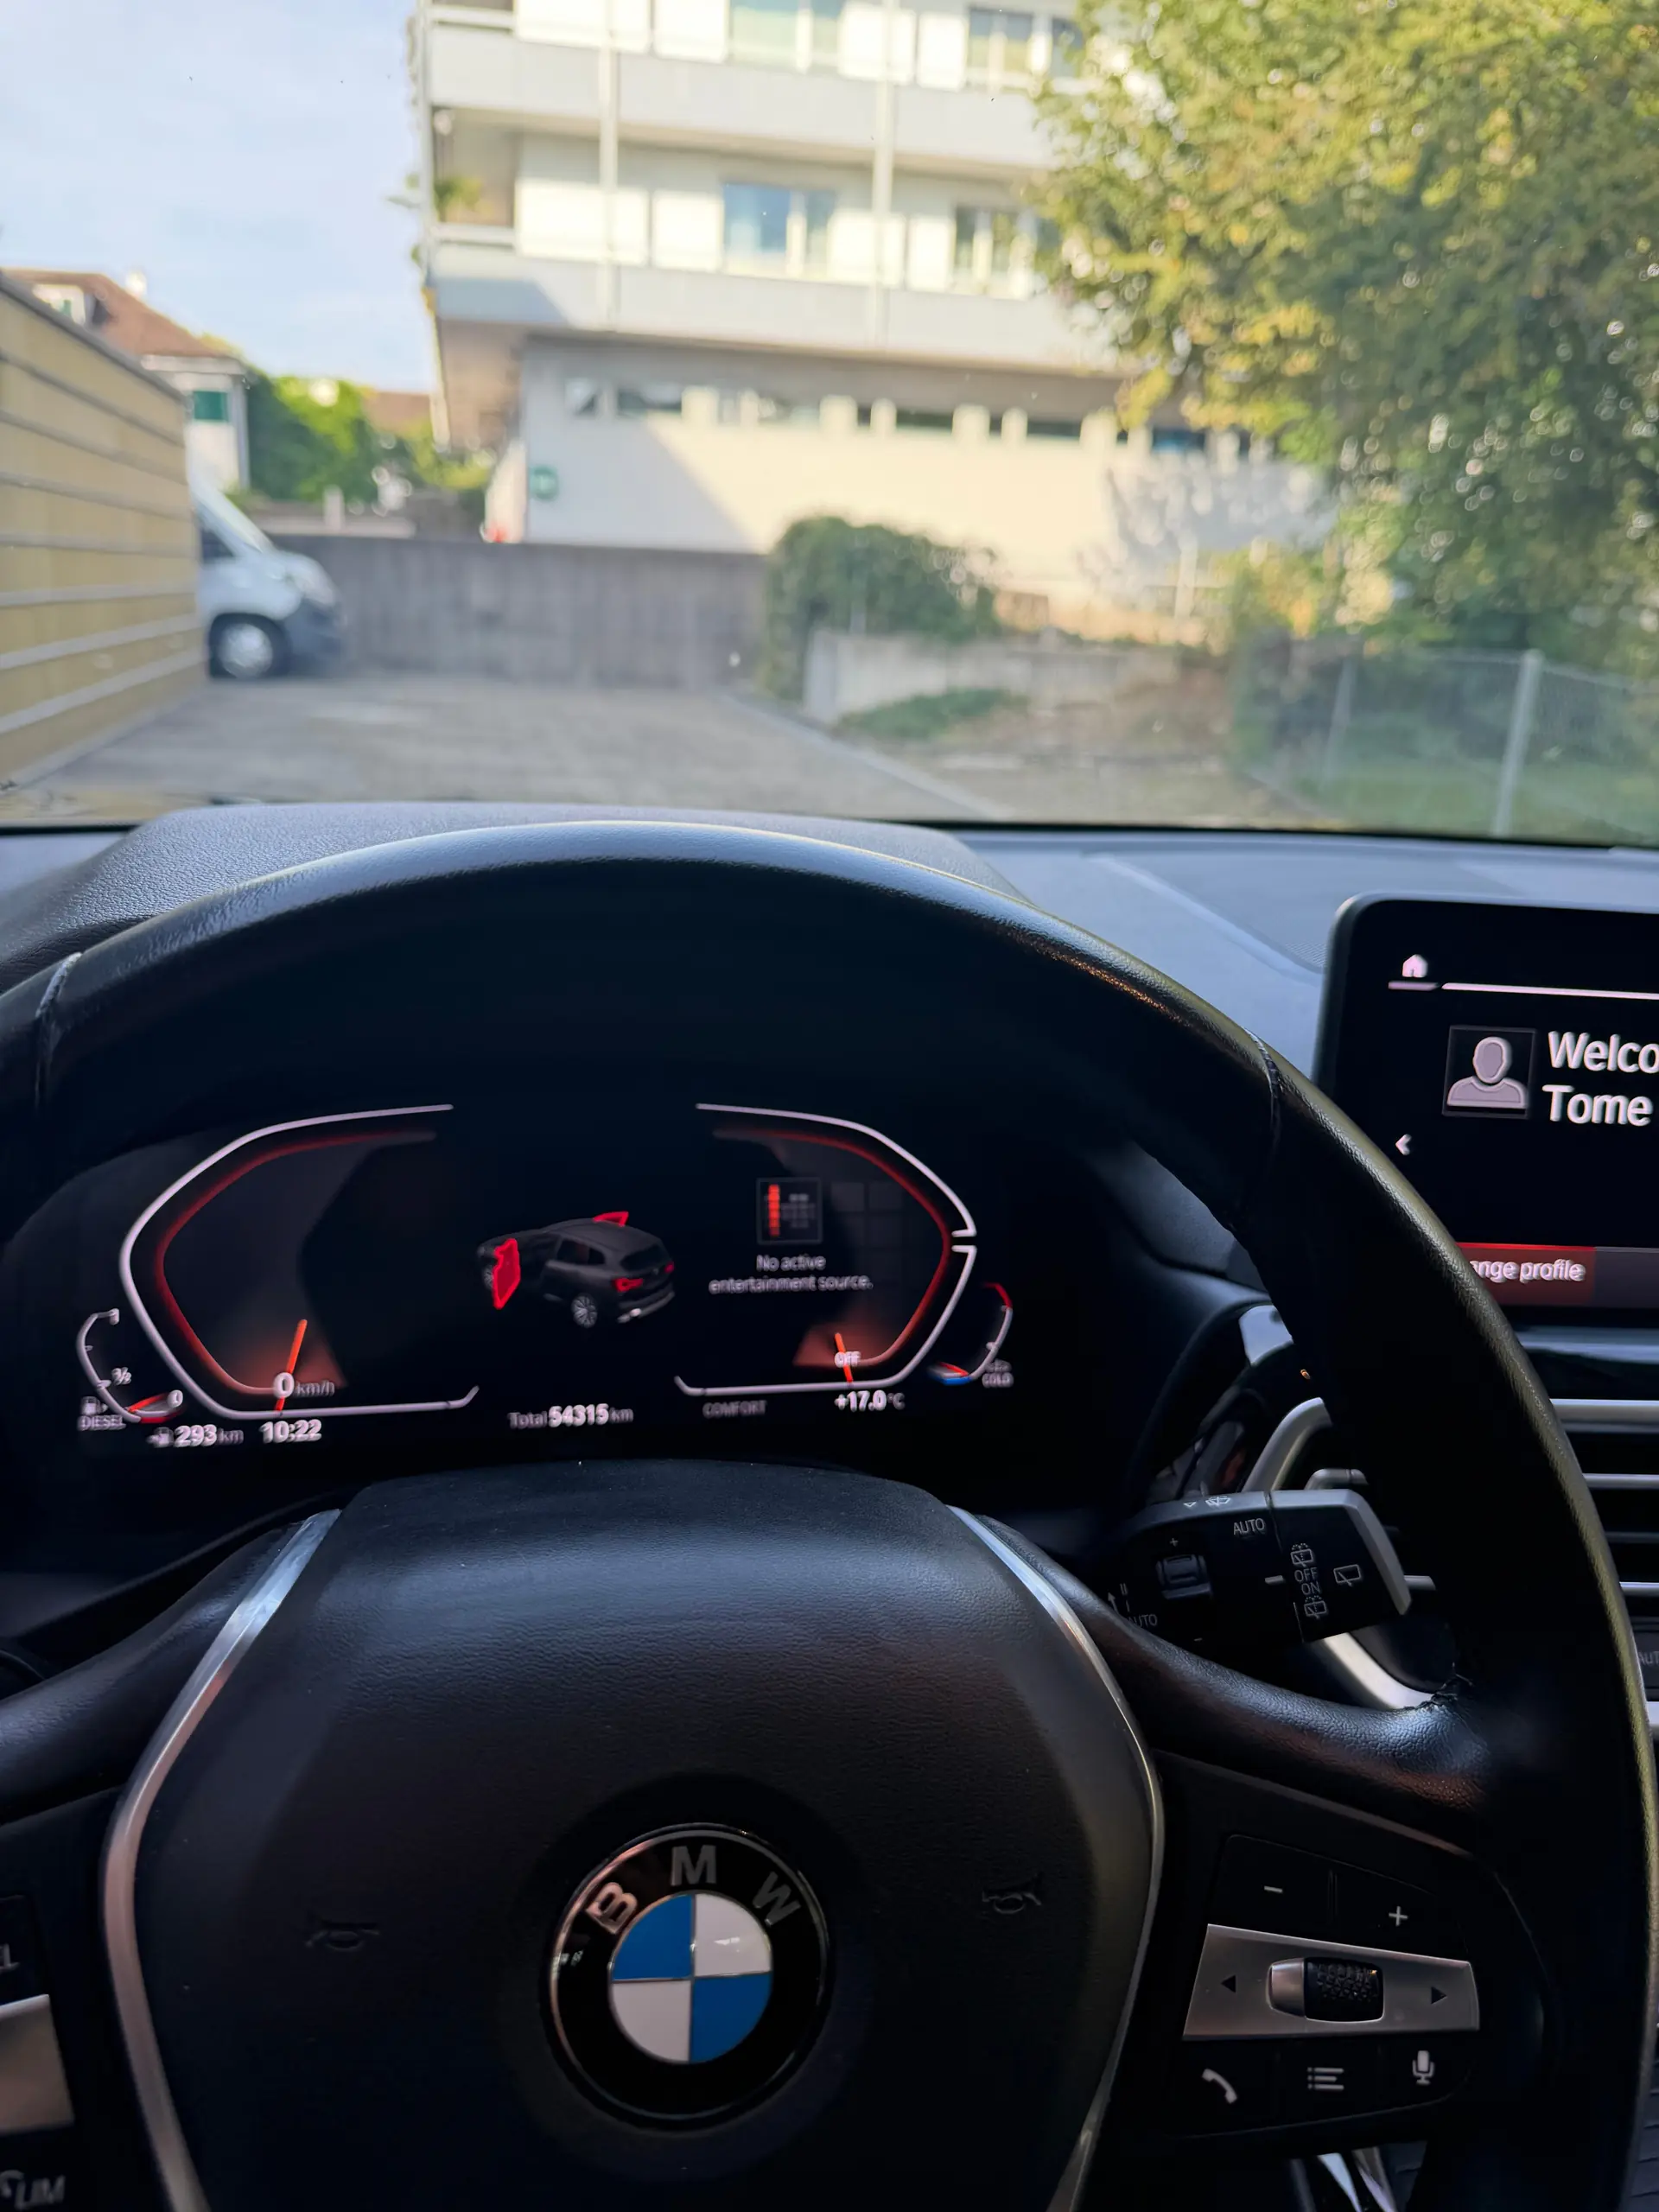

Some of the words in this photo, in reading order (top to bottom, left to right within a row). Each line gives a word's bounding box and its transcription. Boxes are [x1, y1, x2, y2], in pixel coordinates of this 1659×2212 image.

[1548, 1031, 1659, 1074] Welco
[1542, 1084, 1653, 1126] Tome
[756, 1255, 779, 1272] No
[780, 1253, 827, 1271] active
[1519, 1258, 1586, 1284] profile
[709, 1274, 817, 1295] entertainment
[817, 1274, 874, 1292] source.
[835, 1351, 861, 1369] OFF
[272, 1371, 295, 1398] 0
[295, 1381, 335, 1396] km/h
[507, 1410, 548, 1430] Total
[548, 1403, 609, 1427] 54315
[609, 1406, 634, 1424] km
[702, 1400, 767, 1418] COMFORT
[77, 1414, 127, 1432] DIESEL
[259, 1419, 322, 1444] 10:22
[175, 1423, 217, 1447] 293
[218, 1428, 245, 1446] km
[1233, 1516, 1267, 1536] AUTO
[1294, 1566, 1319, 1583] OFF
[1300, 1581, 1322, 1596] ON
[585, 1844, 801, 1935] BMW
